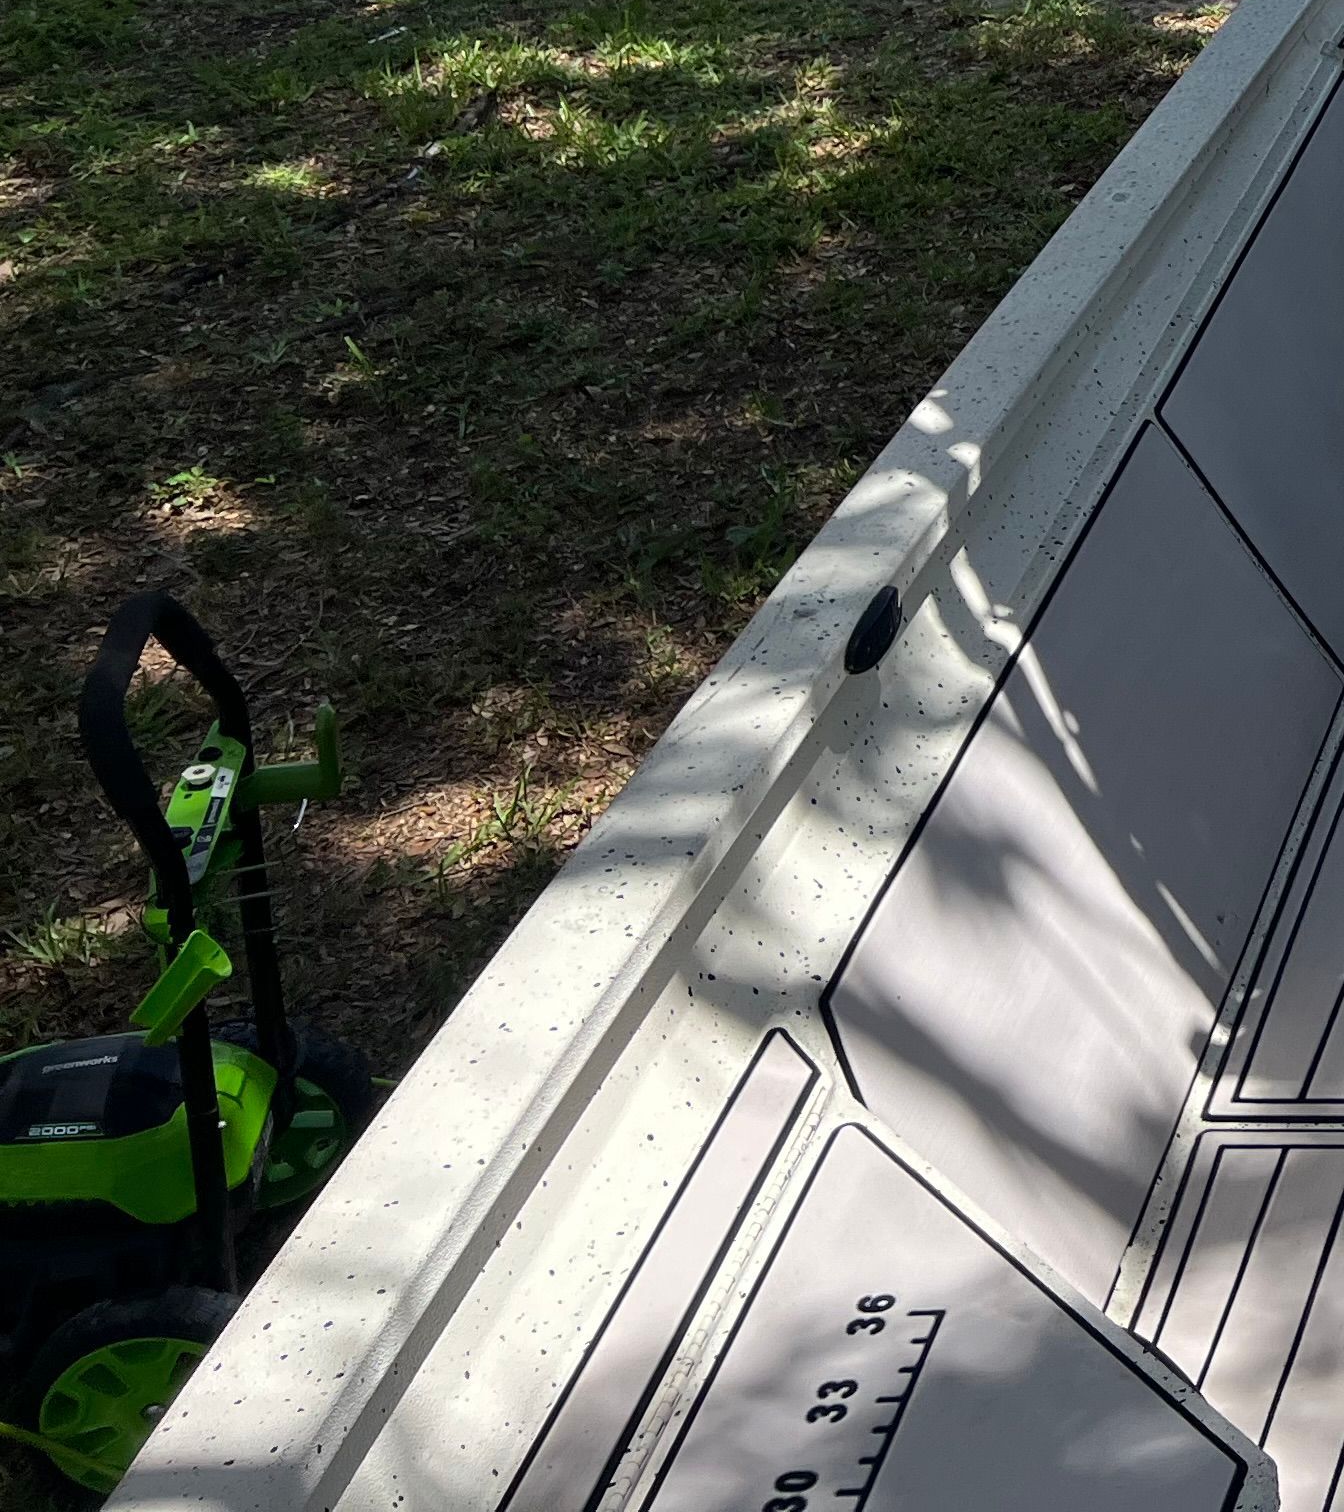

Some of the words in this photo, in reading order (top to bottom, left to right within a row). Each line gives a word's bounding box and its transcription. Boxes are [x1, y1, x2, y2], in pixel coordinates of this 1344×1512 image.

[846, 1294, 897, 1336] 36
[806, 1379, 859, 1424] 33
[761, 1470, 820, 1512] 30
